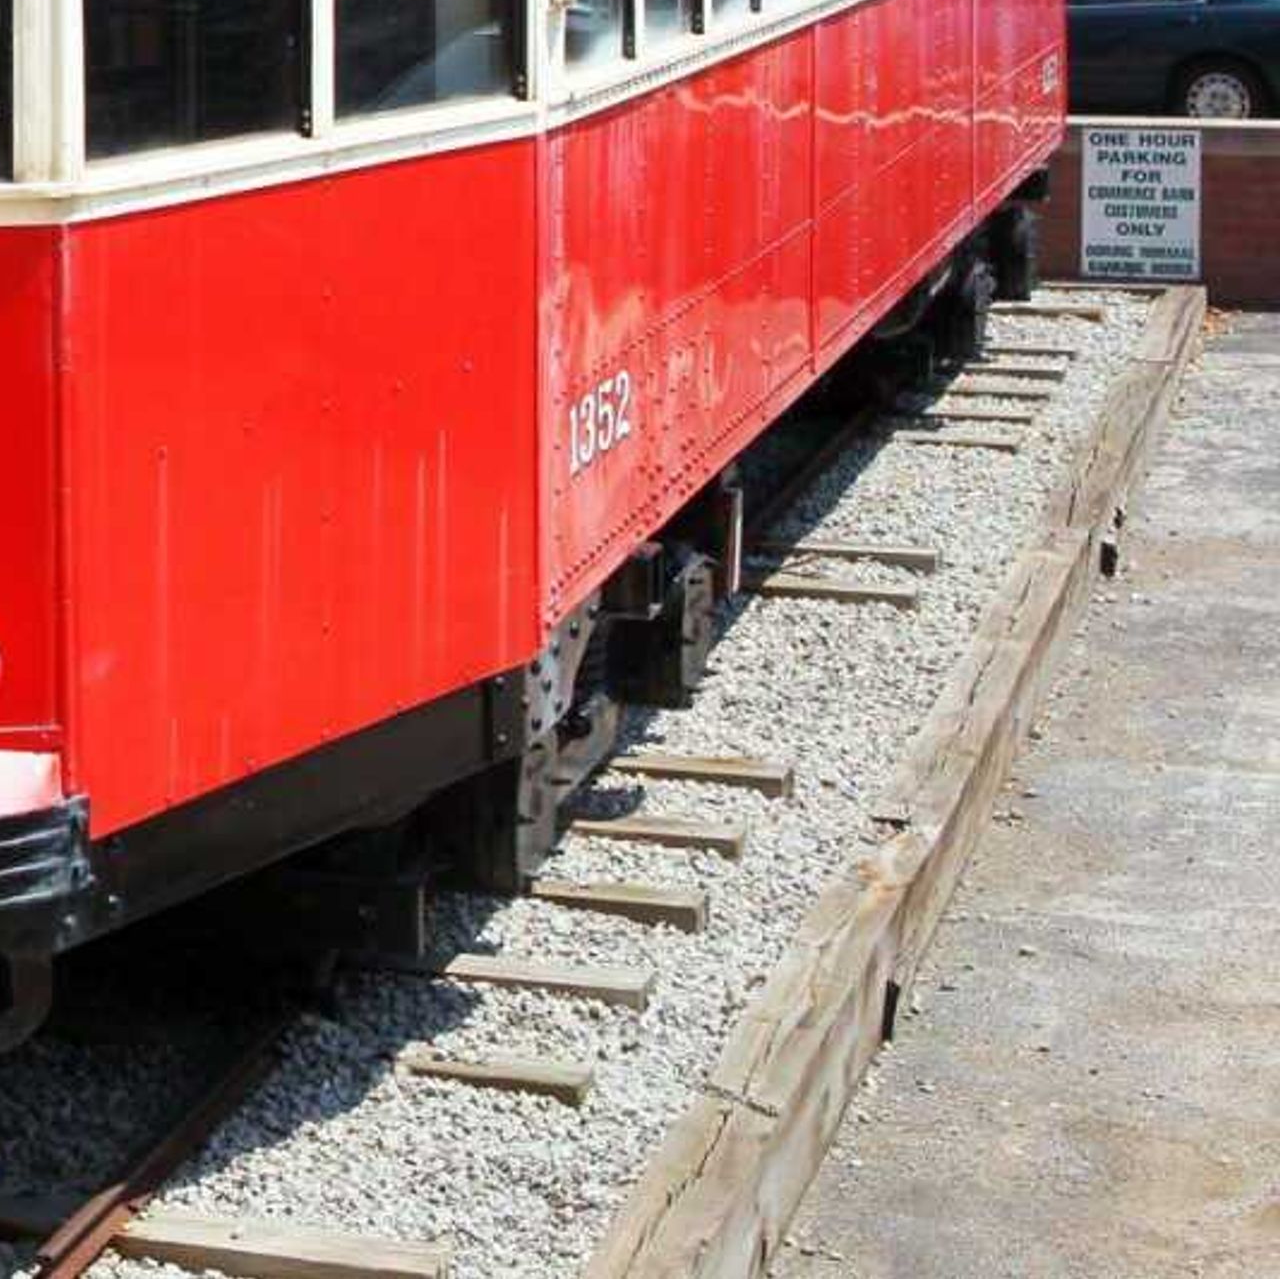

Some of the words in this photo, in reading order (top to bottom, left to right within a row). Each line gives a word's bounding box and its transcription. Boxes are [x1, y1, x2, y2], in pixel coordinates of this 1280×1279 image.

[1089, 132, 1128, 146] ONE
[1138, 134, 1195, 148] HOUR
[1097, 150, 1186, 164] PARKING
[1121, 170, 1162, 183] FOR
[1116, 221, 1165, 236] ONLY
[569, 369, 631, 475] 1352
